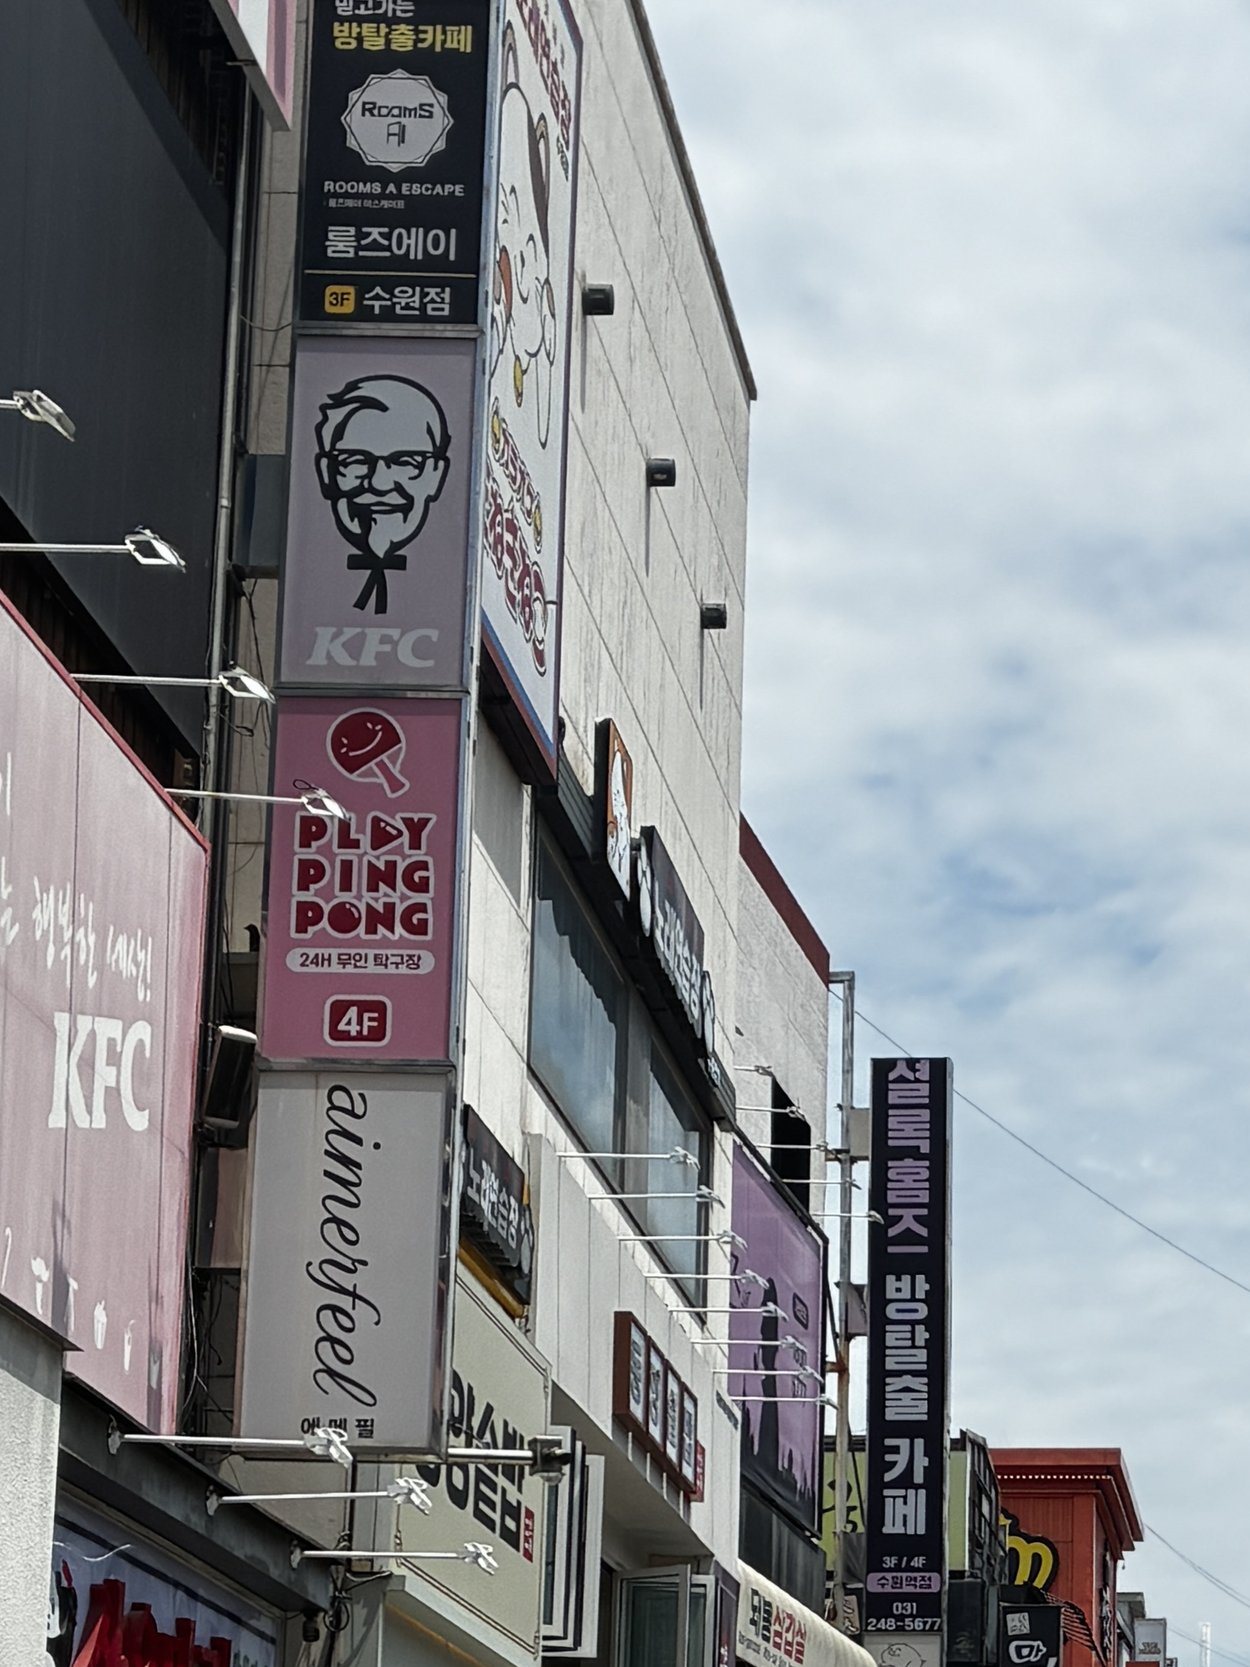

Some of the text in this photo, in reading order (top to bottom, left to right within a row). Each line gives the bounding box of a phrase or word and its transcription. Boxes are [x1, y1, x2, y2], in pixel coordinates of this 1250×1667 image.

[333, 22, 472, 52] 방탈출카페
[324, 181, 465, 197] ROOMS A ESCAPE
[325, 226, 456, 260] 룸즈에이
[329, 286, 450, 316] 3F 수원점
[306, 627, 439, 667] KFC
[294, 812, 435, 853] PLAY
[294, 857, 435, 896] PING
[291, 900, 433, 940] PONG
[299, 951, 422, 971] 24H 무인 탁구장
[336, 1010, 379, 1038] 4F
[48, 1011, 152, 1132] KFC
[887, 1060, 930, 1253] 셜록홈즈
[302, 1082, 381, 1409] aimerfeel
[883, 1274, 930, 1535] 방탈출 카페
[301, 1415, 375, 1440] 에메필
[882, 1556, 898, 1568] 3F
[910, 1556, 926, 1568] 4F
[876, 1574, 932, 1590] 수원역점
[893, 1602, 917, 1615] 031
[867, 1618, 942, 1631] 248-5677
